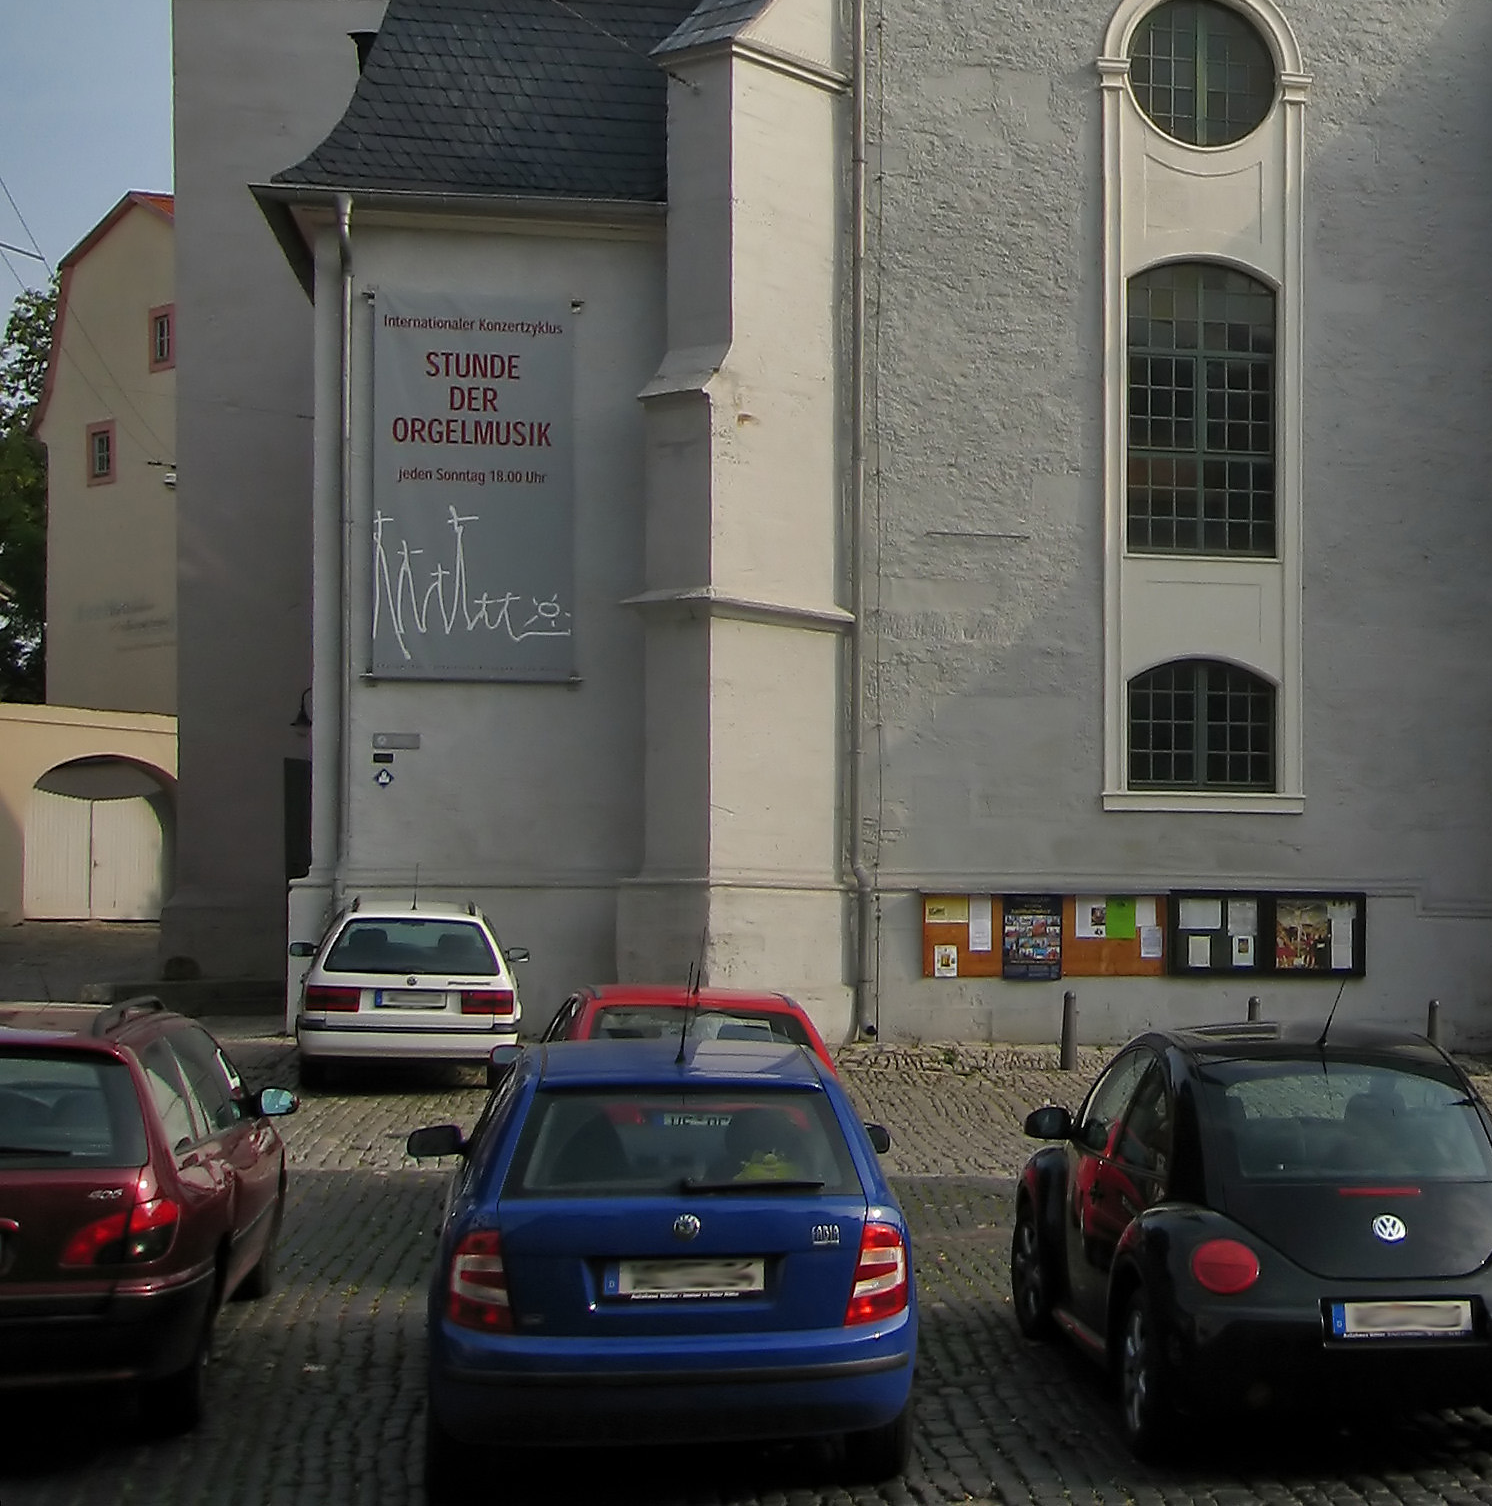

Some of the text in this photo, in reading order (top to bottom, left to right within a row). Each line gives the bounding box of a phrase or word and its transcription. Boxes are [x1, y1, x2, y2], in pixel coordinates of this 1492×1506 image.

[384, 314, 563, 337] Internationaler Konzertzyklus
[425, 351, 521, 380] STUNDE
[449, 386, 499, 412] DER
[392, 416, 552, 447] ORGELMUSIK
[398, 466, 548, 485] jeden Sonntag 18.00 Uhr
